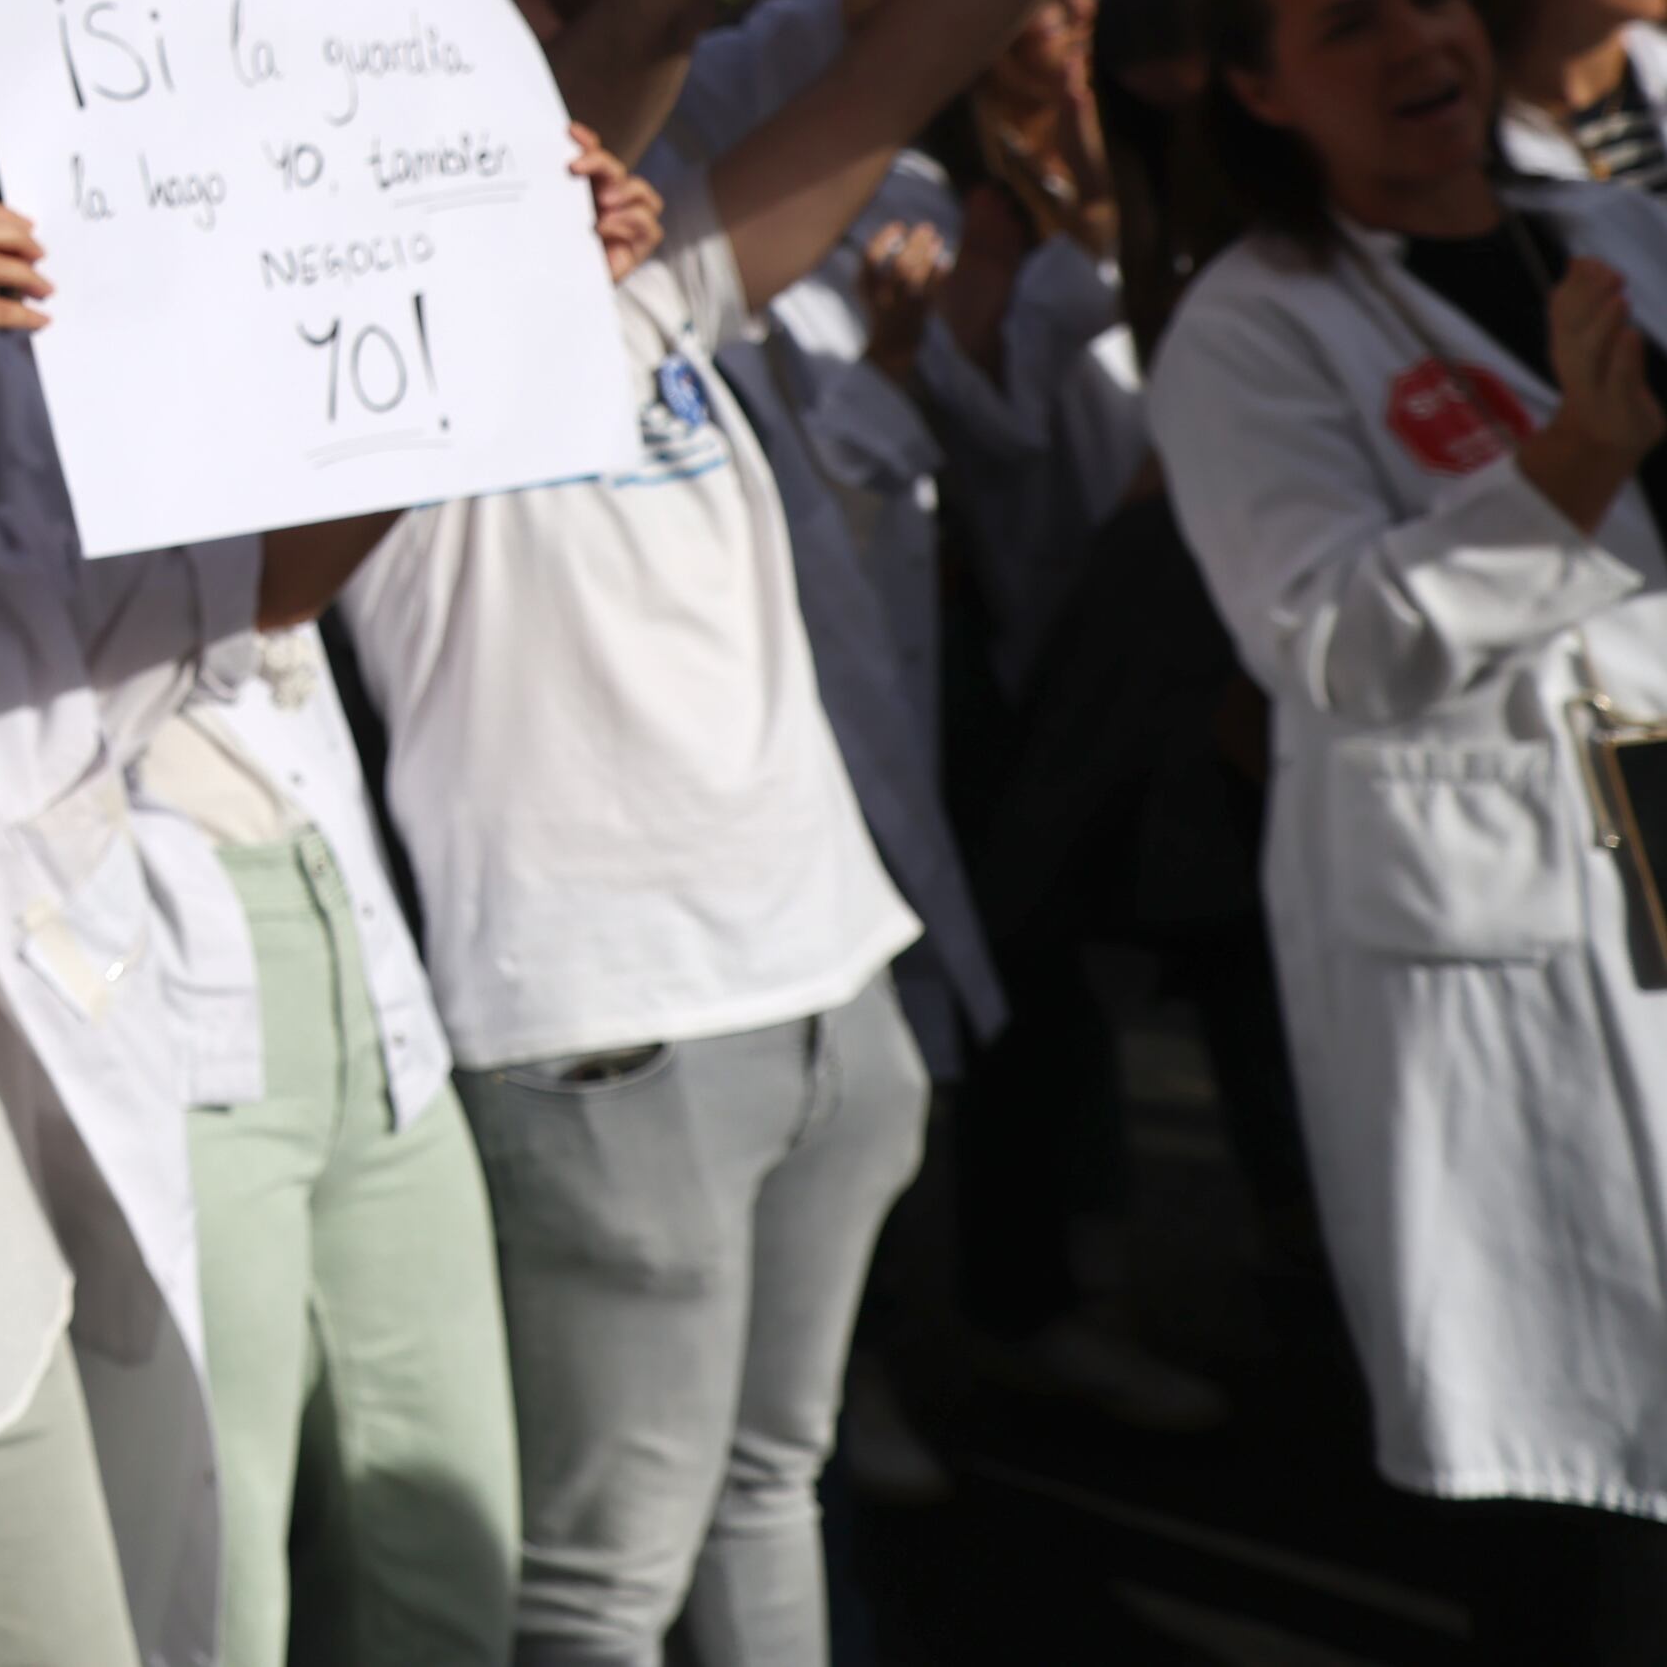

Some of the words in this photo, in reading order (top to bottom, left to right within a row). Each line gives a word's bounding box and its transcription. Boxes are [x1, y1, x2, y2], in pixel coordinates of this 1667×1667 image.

[322, 10, 475, 128] guardia
[69, 154, 116, 223] la
[138, 150, 227, 231] hago
[364, 130, 516, 189] también
[259, 231, 435, 291] NEGOCIO
[294, 291, 451, 432] YO!
